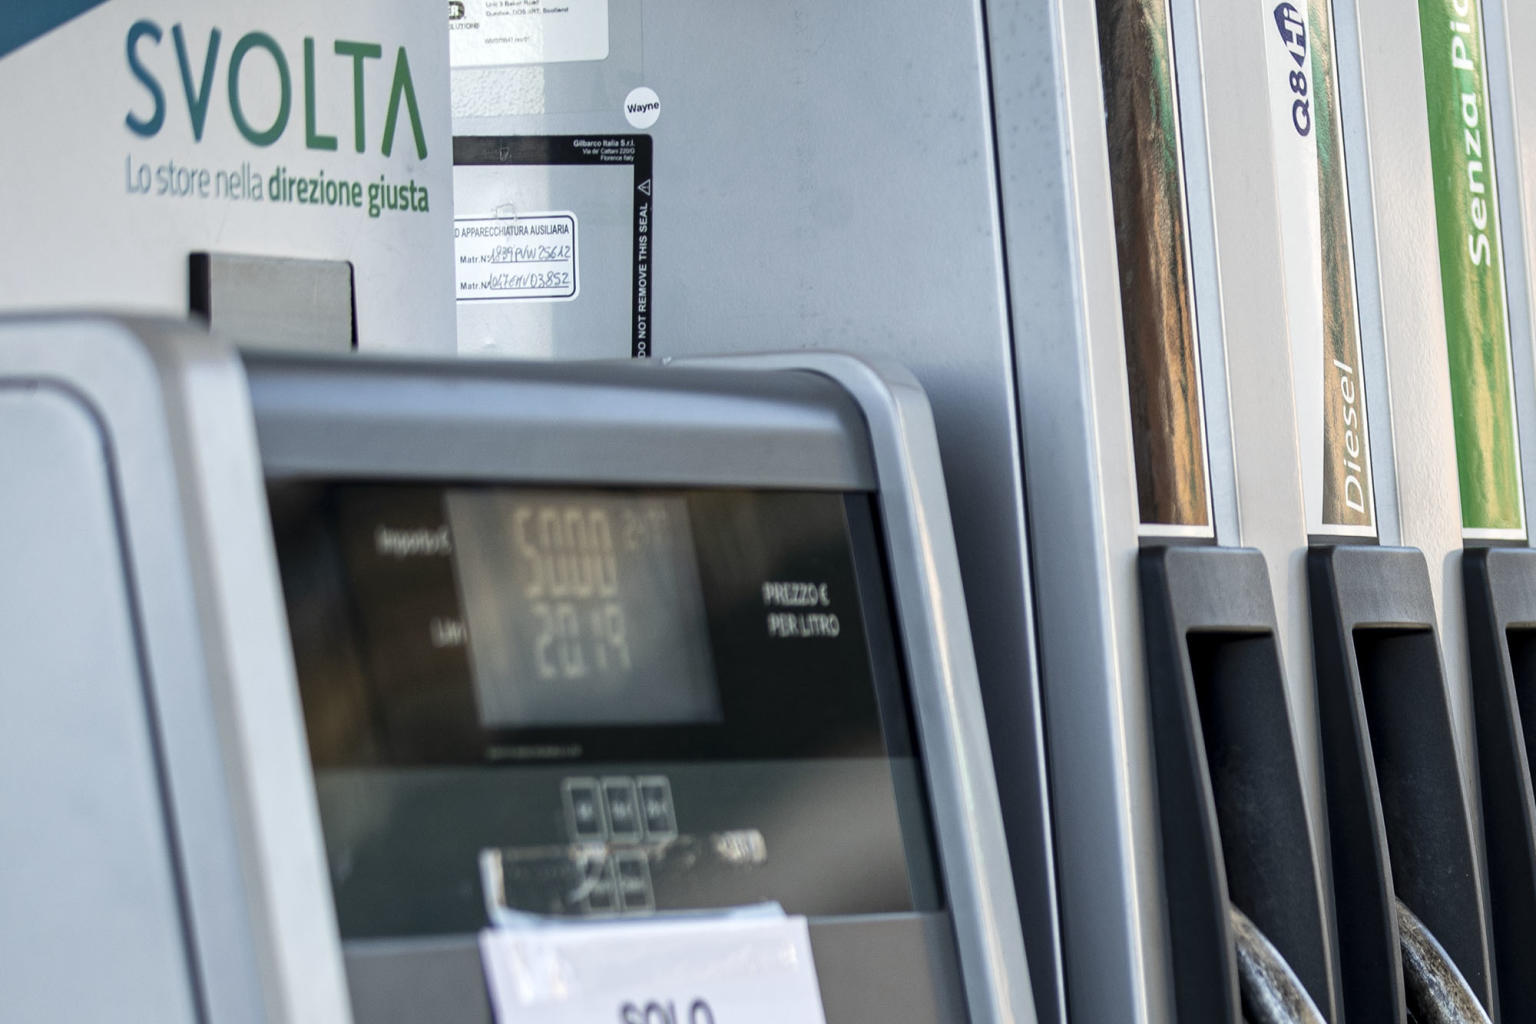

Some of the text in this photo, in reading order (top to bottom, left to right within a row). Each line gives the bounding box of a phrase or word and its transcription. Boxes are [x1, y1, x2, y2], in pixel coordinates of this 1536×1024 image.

[124, 18, 428, 161] SVOLTA
[627, 102, 660, 113] Wayne
[573, 139, 602, 148] Gilbarco
[603, 139, 619, 147] Italia
[125, 153, 430, 218] Lo store nella direzione giusta
[1461, 93, 1491, 266] Senza
[461, 225, 529, 237] APPARECCHIATURA
[530, 224, 570, 235] AUSILIARIA
[639, 203, 648, 233] SEAL
[638, 235, 648, 261] THIS
[638, 263, 648, 312] REMOVE
[638, 315, 647, 339] NOT
[1333, 359, 1365, 513] Diesel
[761, 581, 829, 607] PREZZO €
[767, 613, 841, 638] PER LITRO
